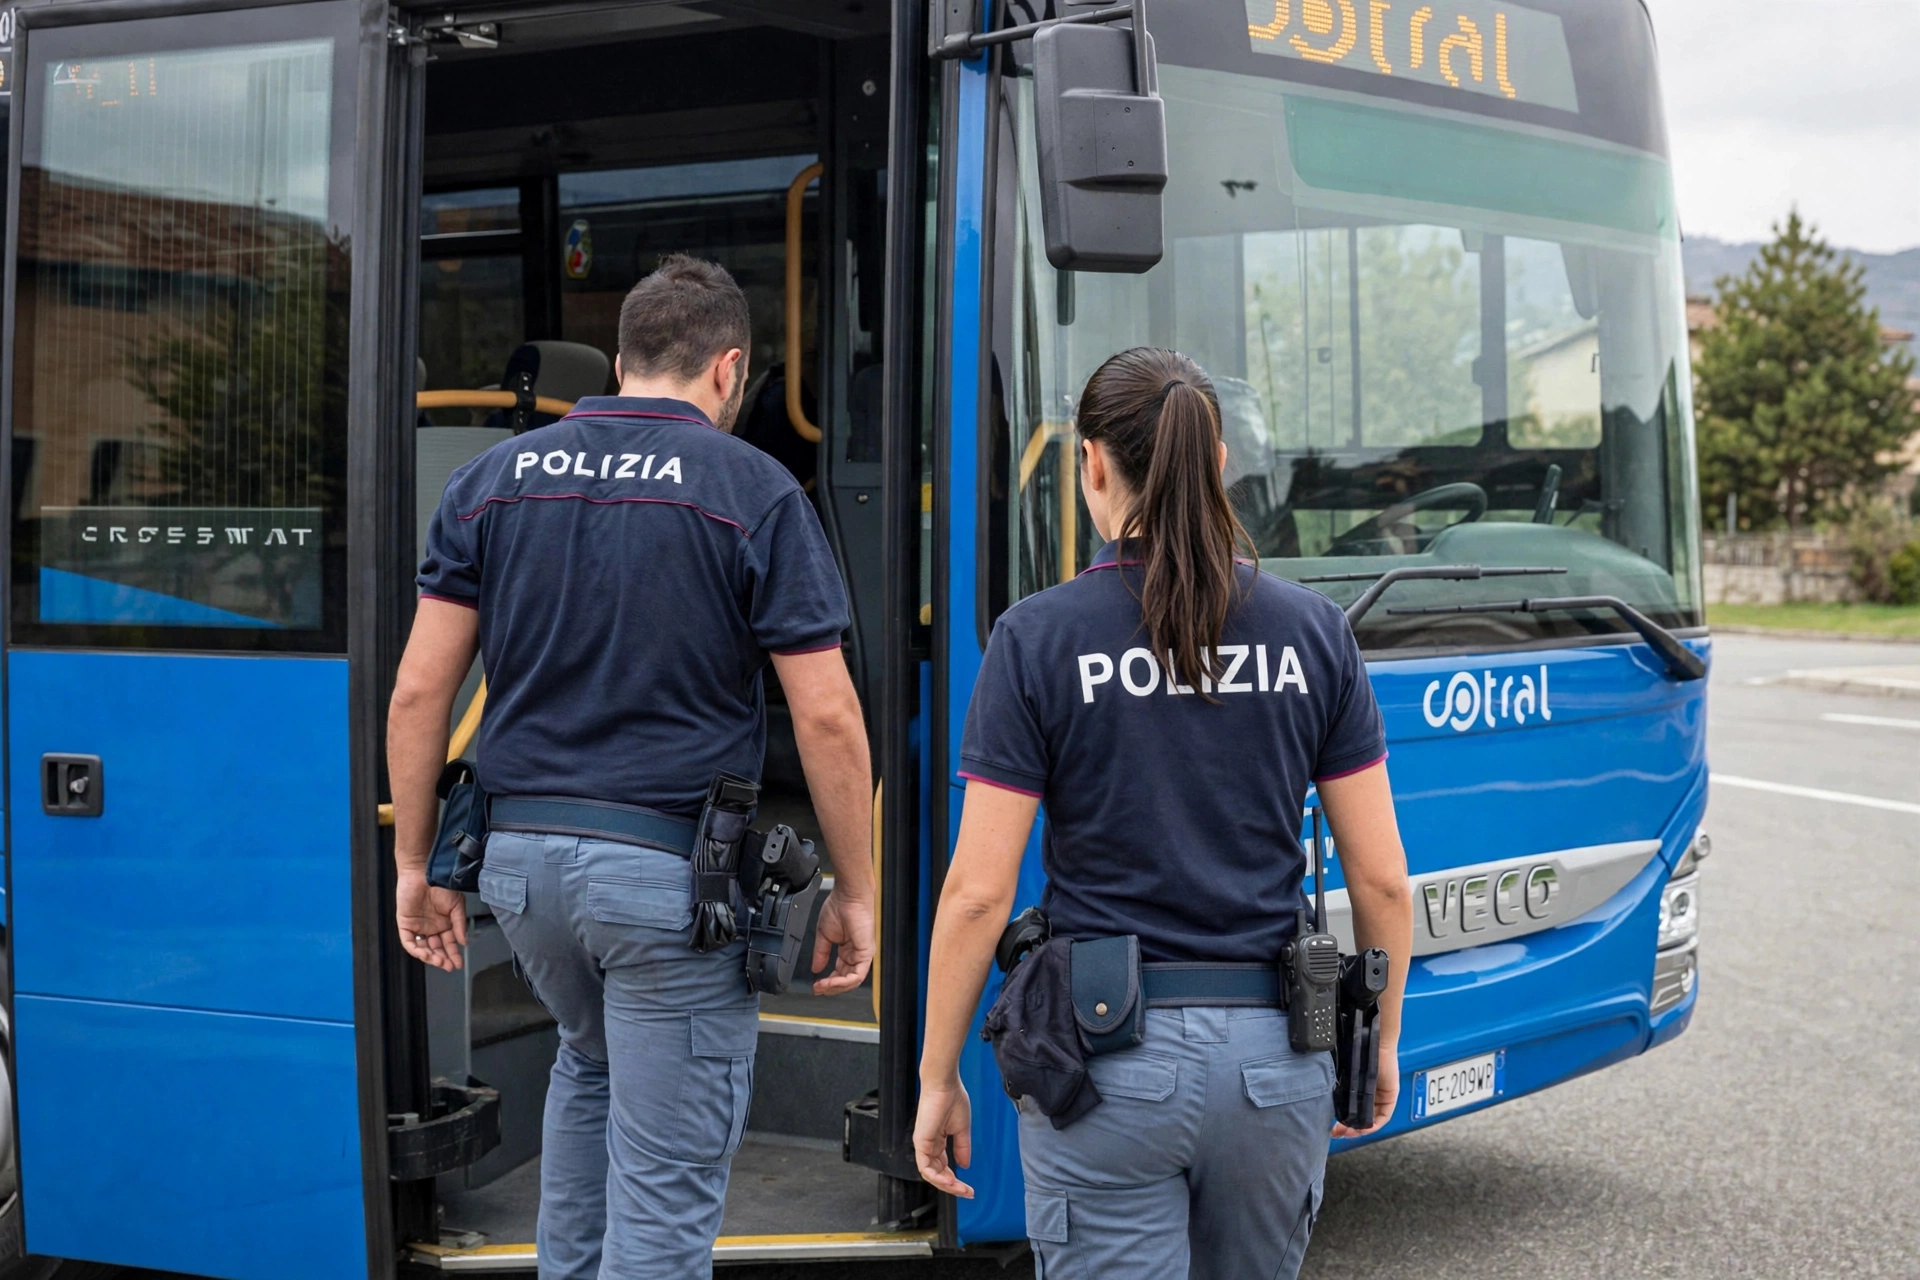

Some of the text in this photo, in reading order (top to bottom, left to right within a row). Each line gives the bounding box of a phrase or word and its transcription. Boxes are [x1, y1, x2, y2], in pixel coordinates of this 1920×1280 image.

[515, 449, 682, 484] POLIZIA
[1077, 644, 1309, 704] POLIZIA
[1423, 665, 1551, 732] cotral
